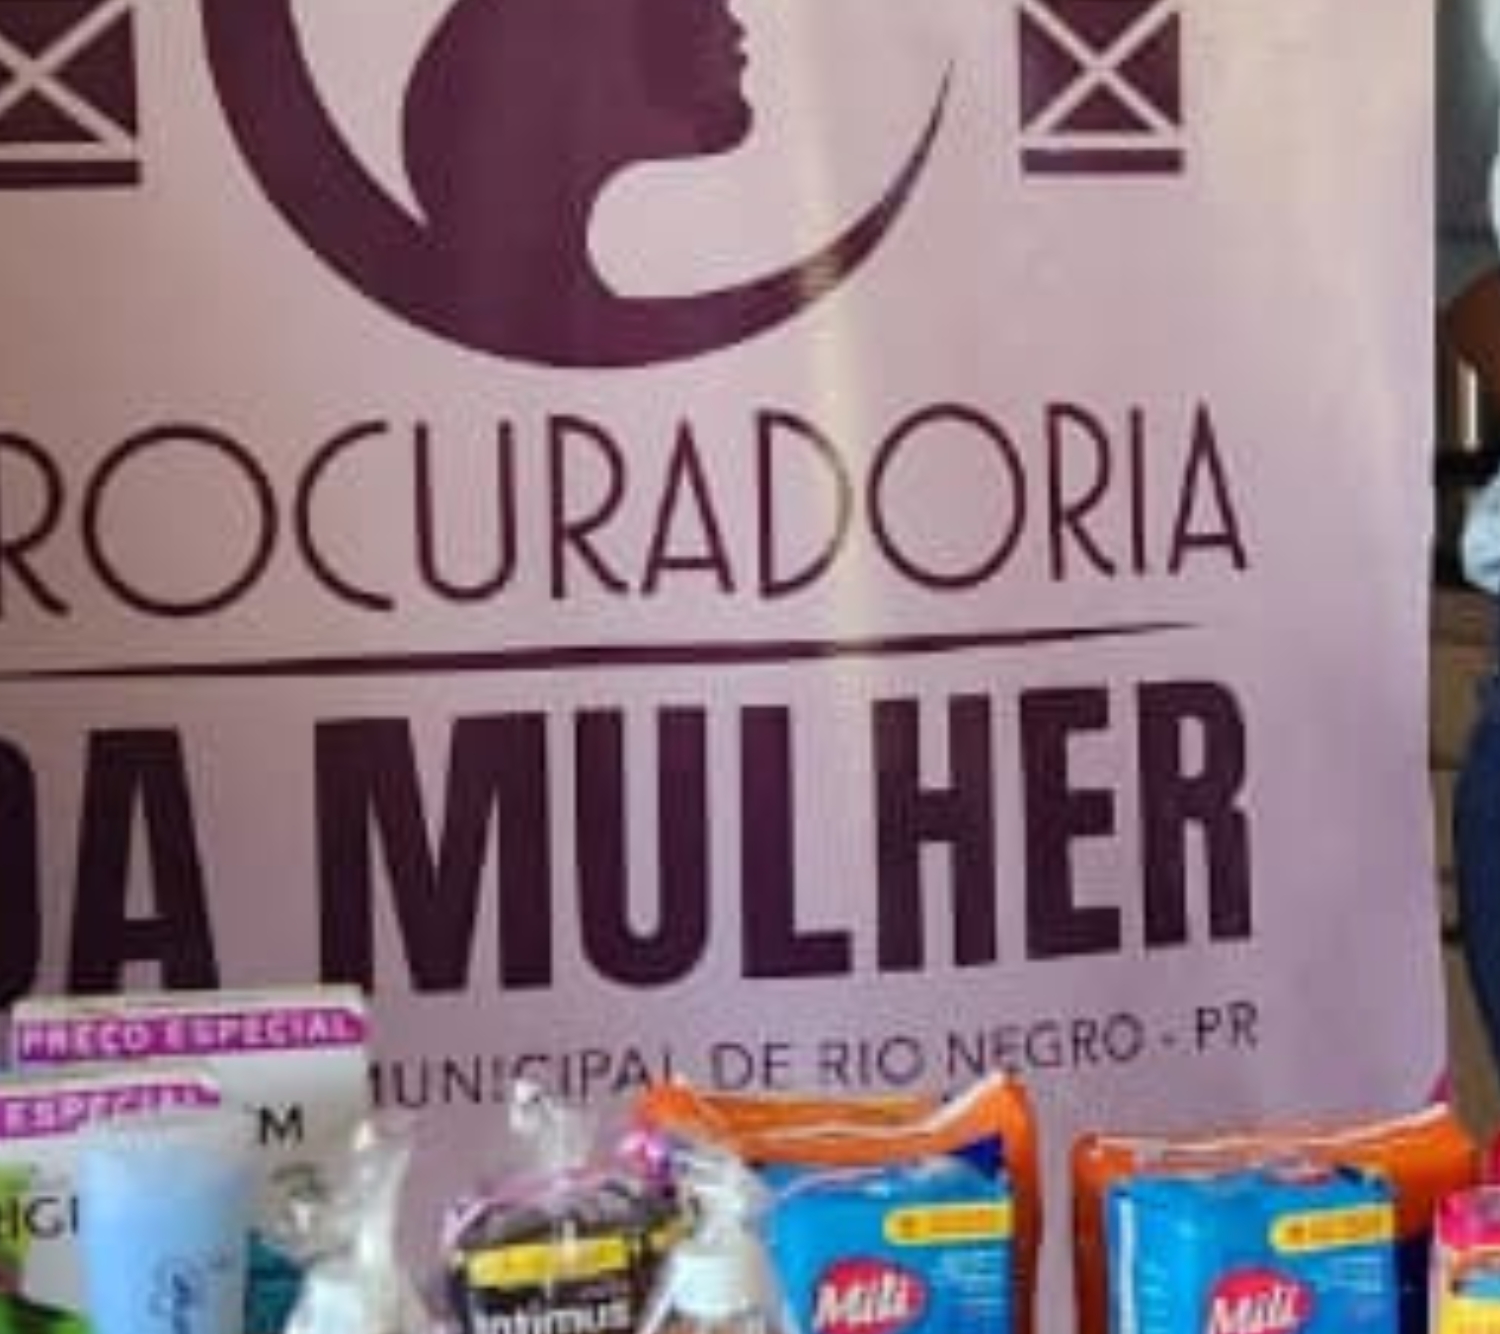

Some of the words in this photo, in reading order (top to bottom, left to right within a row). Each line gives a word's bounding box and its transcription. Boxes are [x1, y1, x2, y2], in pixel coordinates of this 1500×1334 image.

[313, 680, 1253, 996] MULHER
[21, 1019, 150, 1057] PREÇO
[165, 1011, 352, 1050] ESPECIAL
[367, 1043, 678, 1110] UNICIPAL
[708, 1041, 791, 1092] DE
[817, 1035, 926, 1089] RIO
[945, 1011, 1145, 1077] NEGRO
[1195, 1000, 1259, 1051] PR
[811, 1270, 910, 1333] Mili
